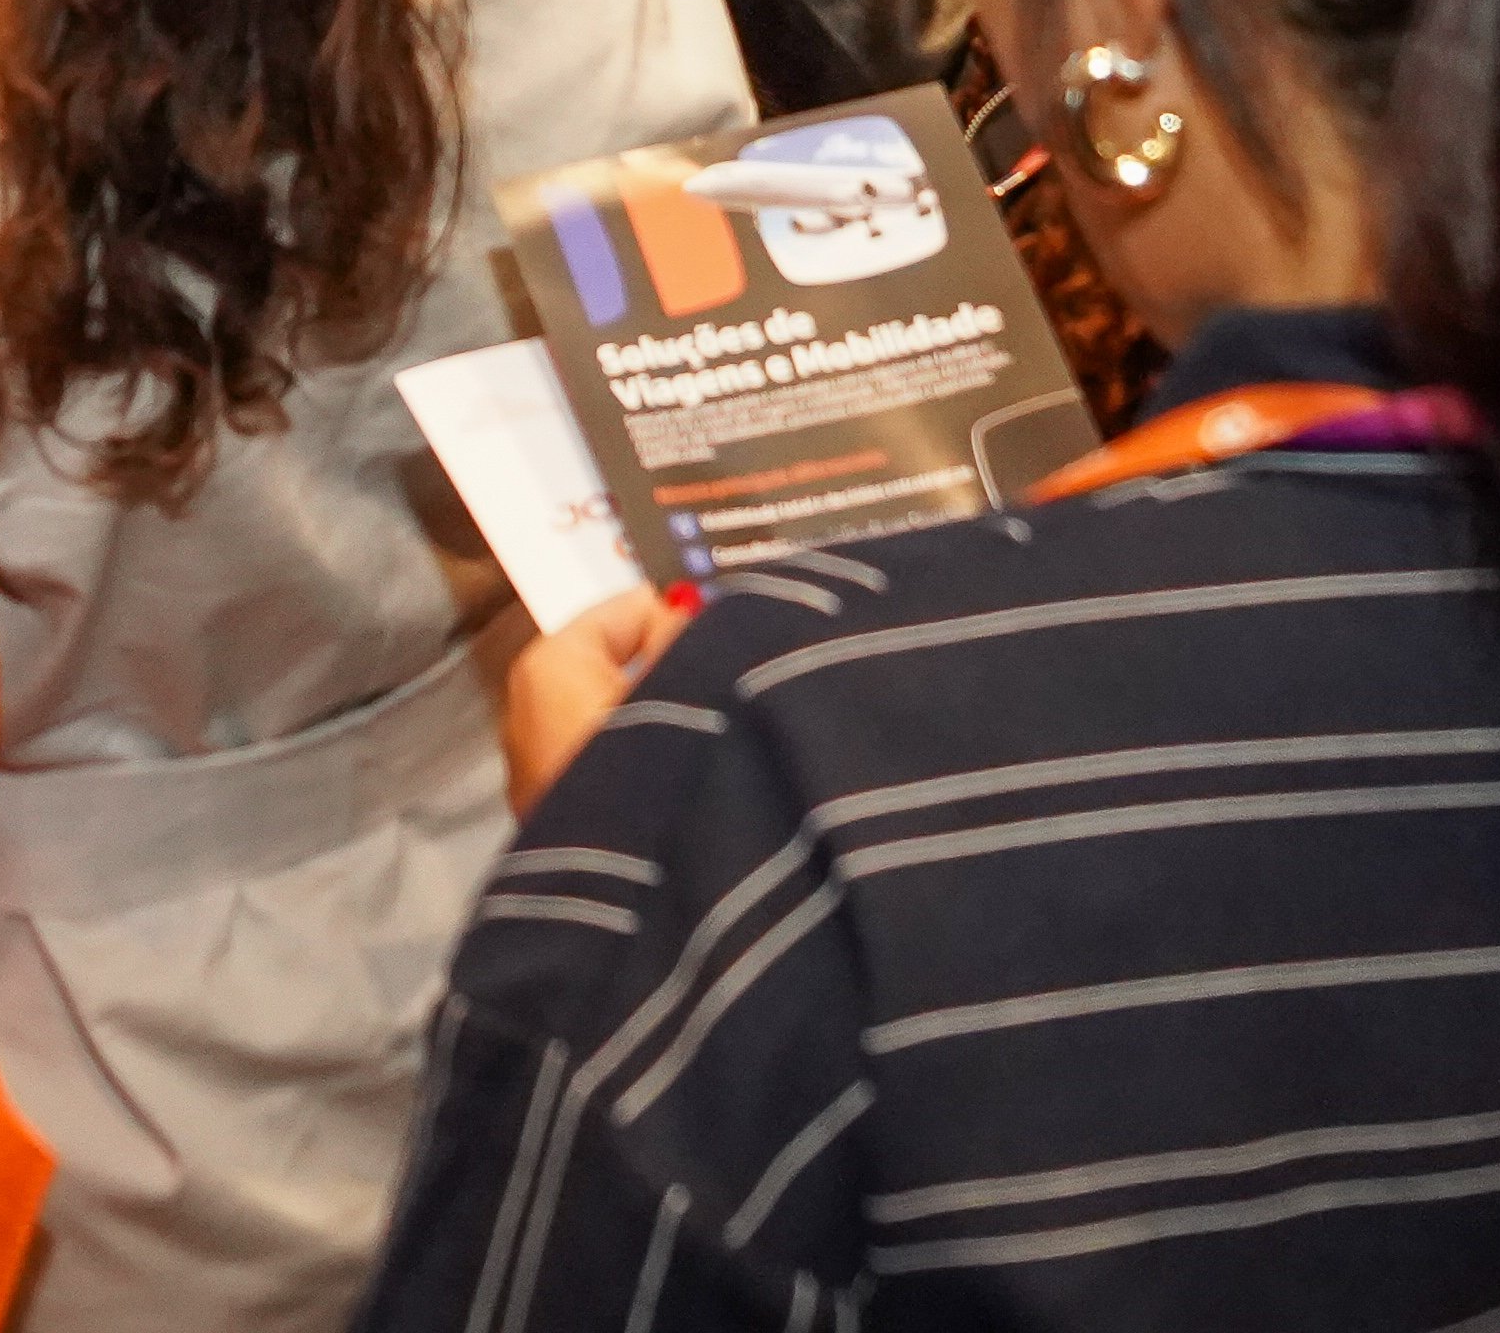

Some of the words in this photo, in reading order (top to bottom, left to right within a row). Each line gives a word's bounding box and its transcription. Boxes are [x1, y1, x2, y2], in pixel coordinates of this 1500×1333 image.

[596, 321, 767, 378] Soluções
[764, 307, 817, 346] de
[609, 359, 768, 411] Viagens
[765, 353, 795, 383] e
[790, 301, 1005, 379] Mobilidade
